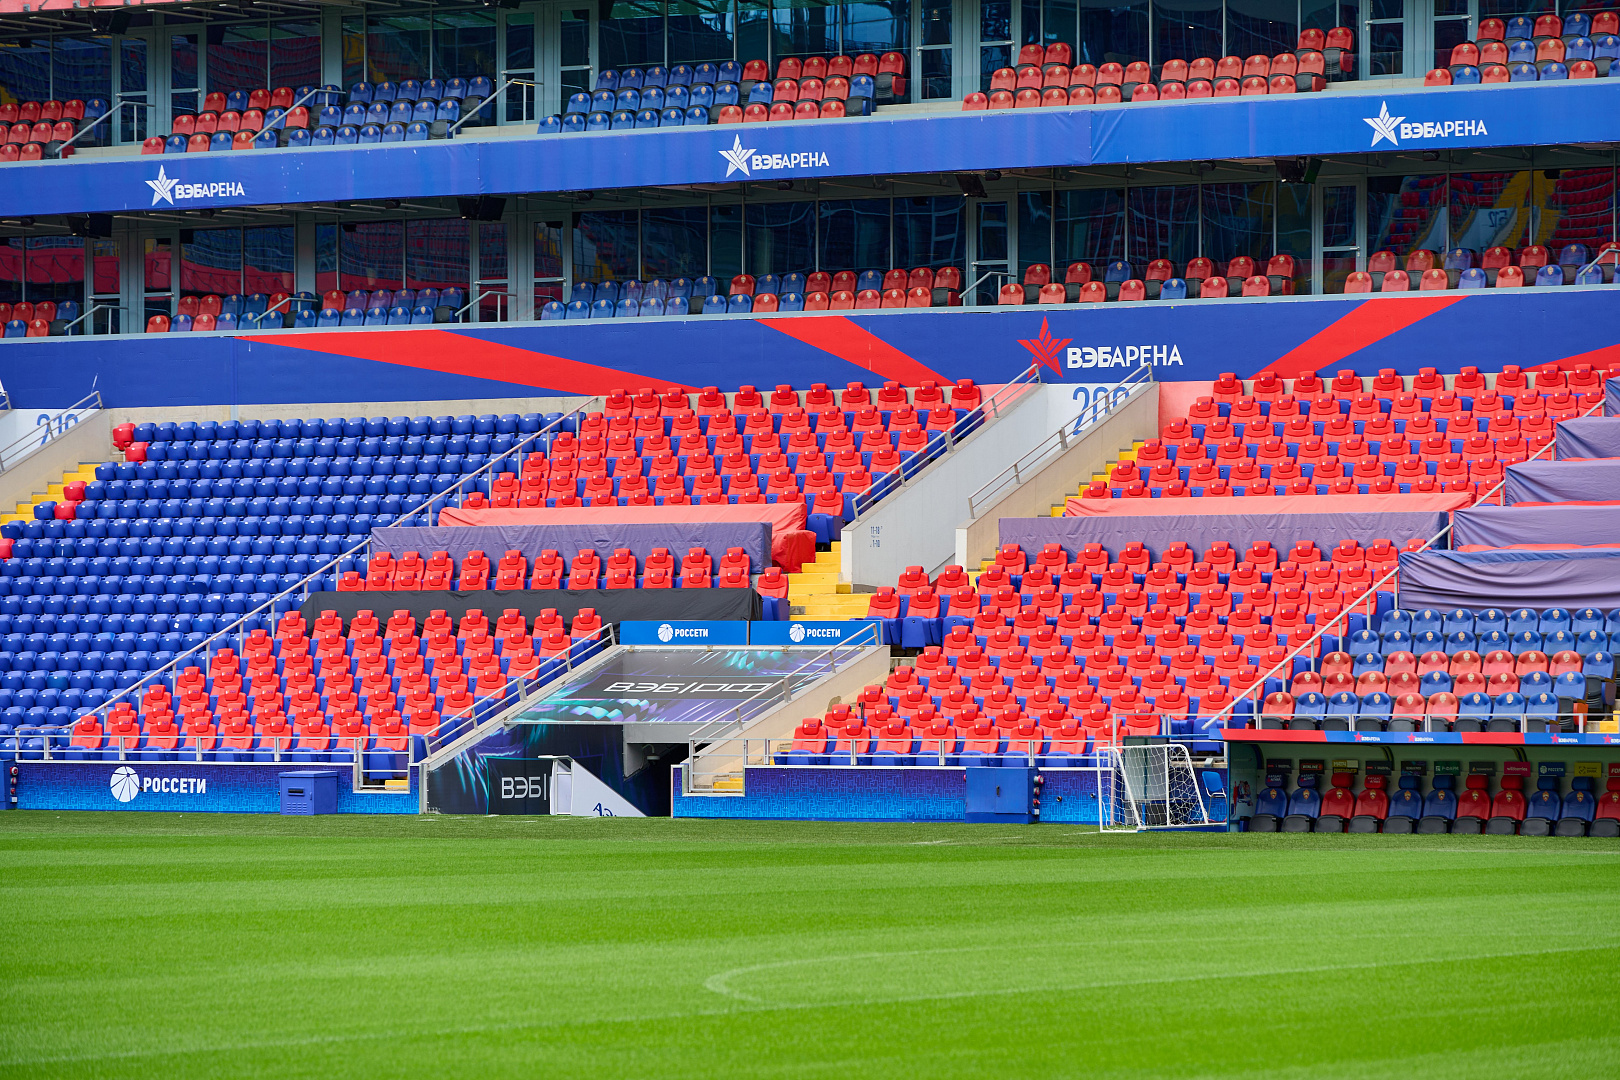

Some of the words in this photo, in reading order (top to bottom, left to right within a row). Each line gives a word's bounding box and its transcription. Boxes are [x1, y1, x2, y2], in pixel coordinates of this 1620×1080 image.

[1400, 119, 1488, 139] ВЭБАРЕНА
[751, 151, 830, 170] ВЭБАРЕНА
[174, 181, 246, 199] ВЭБАРЕНА
[1067, 344, 1184, 369] ВЭБАРЕНА
[674, 628, 709, 638] РОССЕТИ
[806, 628, 841, 638] РОССЕТИ
[143, 777, 207, 794] РОССЕТИ
